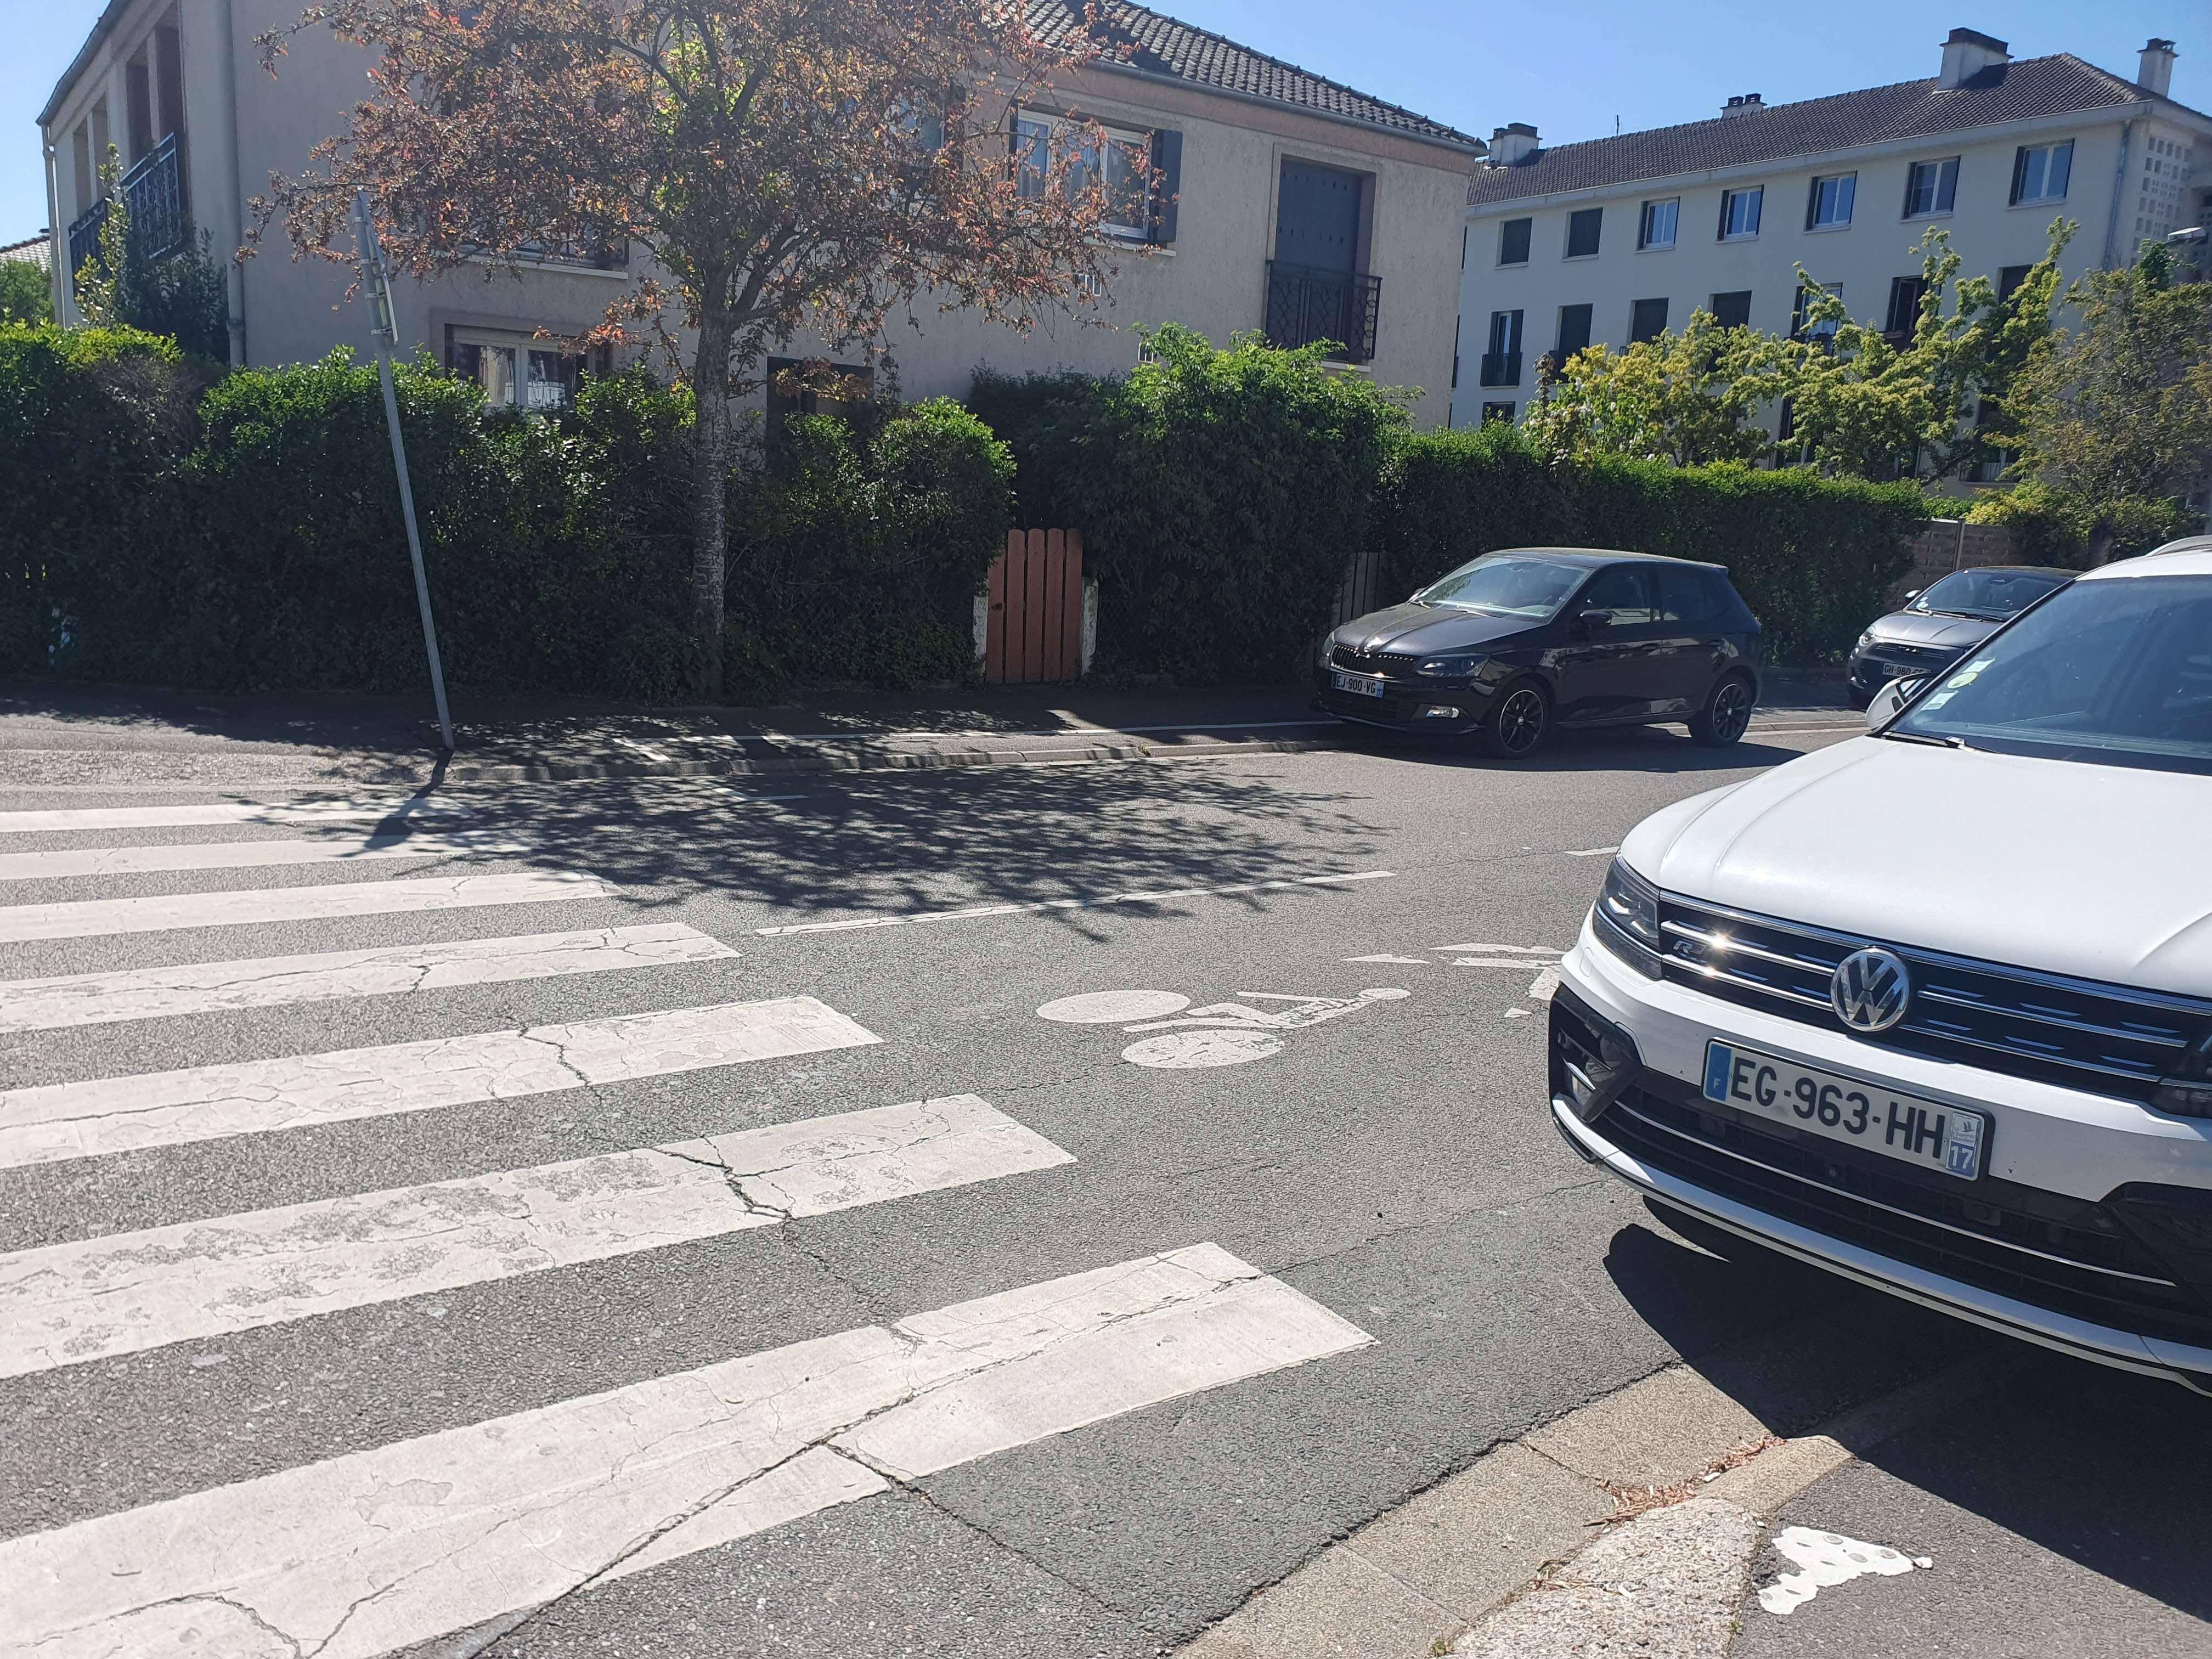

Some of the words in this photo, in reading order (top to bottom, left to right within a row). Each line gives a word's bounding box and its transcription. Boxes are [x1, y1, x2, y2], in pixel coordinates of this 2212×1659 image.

[1336, 675, 1376, 693] EJ-900-VG
[1713, 1077, 1721, 1089] F
[1731, 1057, 1946, 1159] EG-963-HH
[1951, 1146, 1973, 1170] 17
